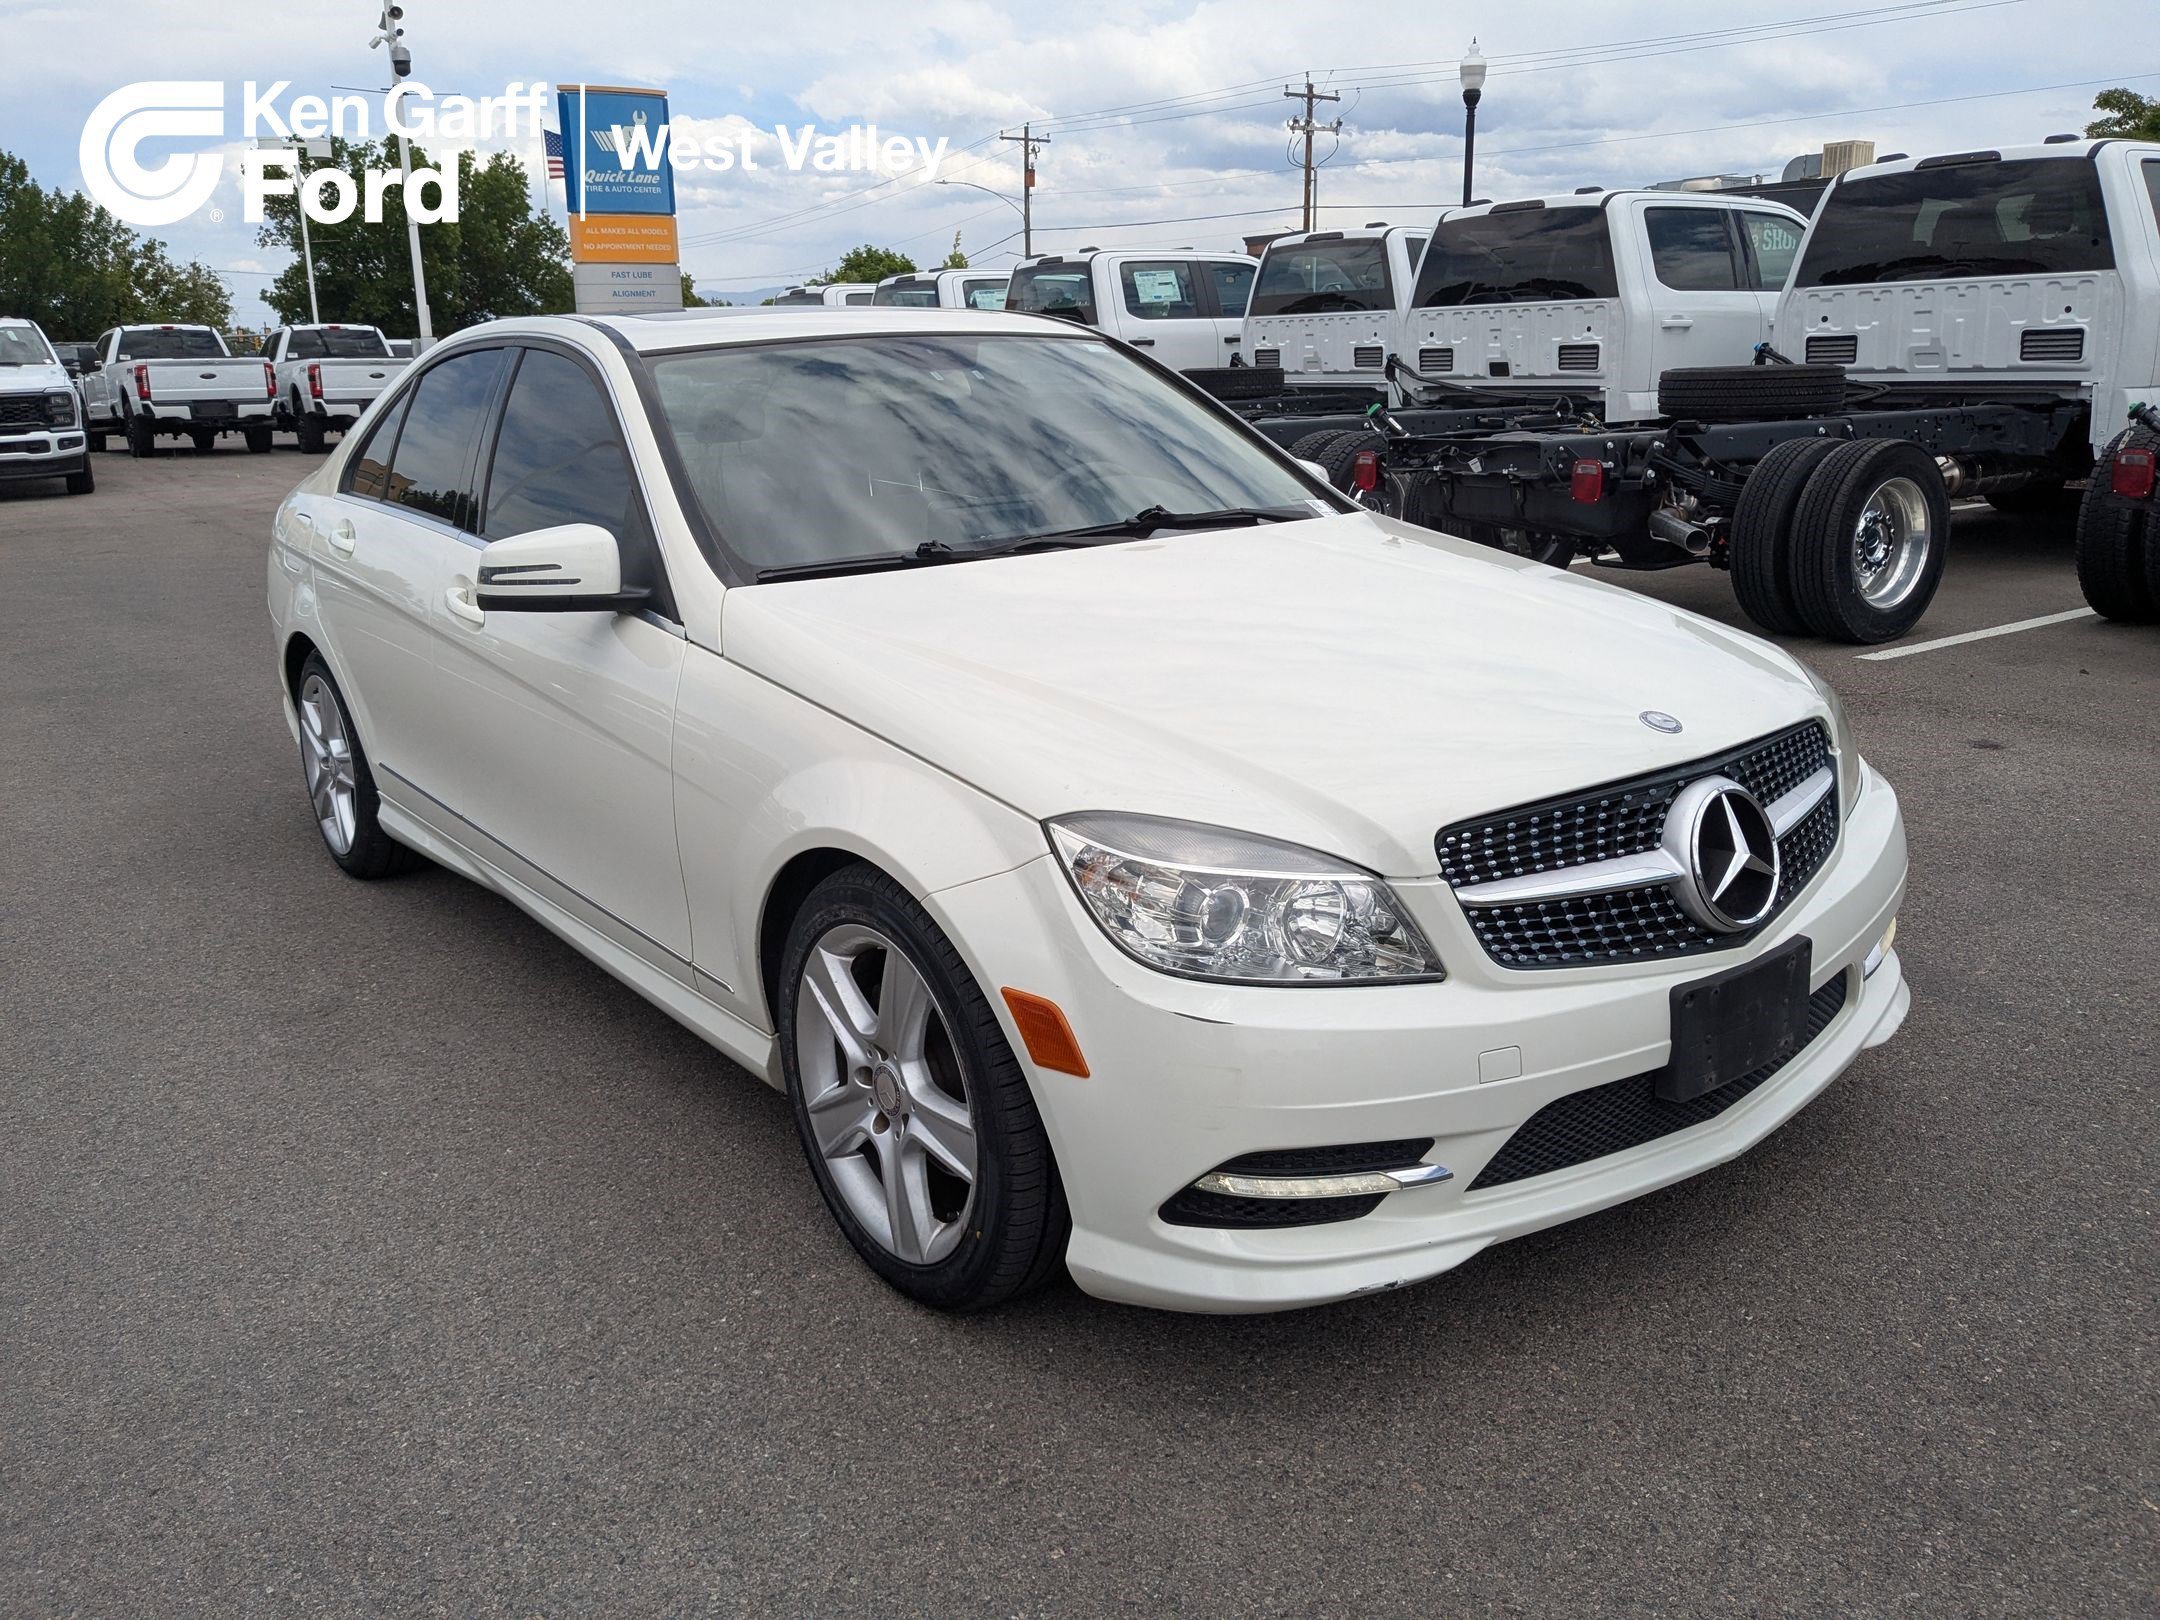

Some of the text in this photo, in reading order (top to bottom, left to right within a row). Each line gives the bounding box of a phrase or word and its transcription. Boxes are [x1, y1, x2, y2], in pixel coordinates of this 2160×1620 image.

[585, 169, 660, 184] Quick Lane
[633, 186, 661, 194] CENTER
[600, 227, 626, 235] MAKES
[596, 243, 645, 251] APPOINTMENT
[646, 243, 672, 251] NEEDED
[611, 271, 653, 279] FAST LUBE
[612, 290, 657, 298] ALIGNMENT
